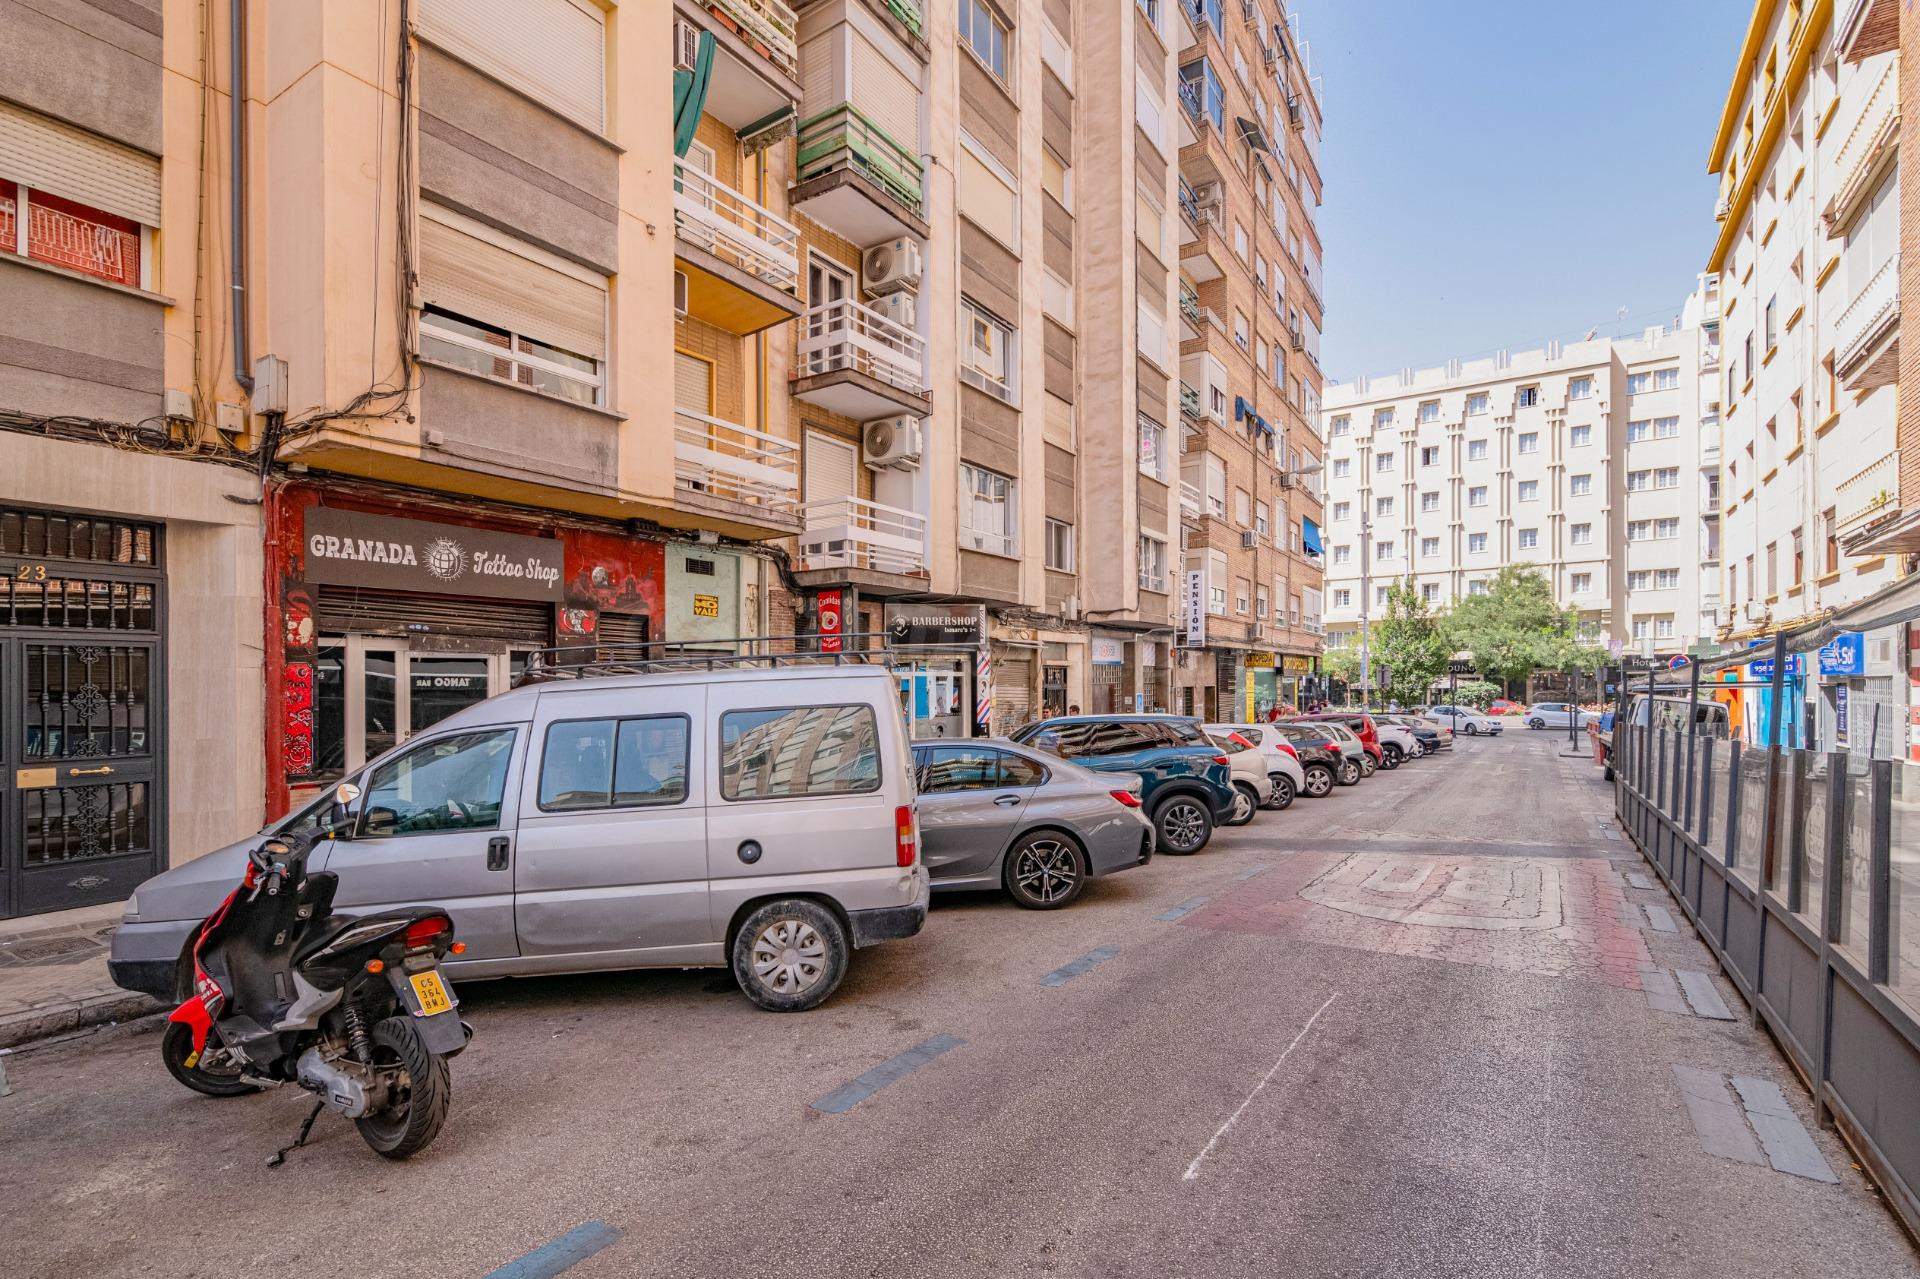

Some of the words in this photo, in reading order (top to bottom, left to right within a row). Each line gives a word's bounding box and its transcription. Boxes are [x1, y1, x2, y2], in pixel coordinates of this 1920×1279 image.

[310, 534, 417, 566] GRANADA
[473, 551, 523, 577] Tattoo
[526, 558, 559, 588] Shop
[17, 565, 46, 580] 23
[818, 595, 841, 607] Comidas
[1191, 574, 1199, 633] PENSIÓN
[694, 607, 718, 617] VALE
[912, 616, 977, 626] BARBERSHOP
[1632, 659, 1657, 667] Hotl
[420, 977, 434, 988] C5
[421, 987, 441, 999] 364
